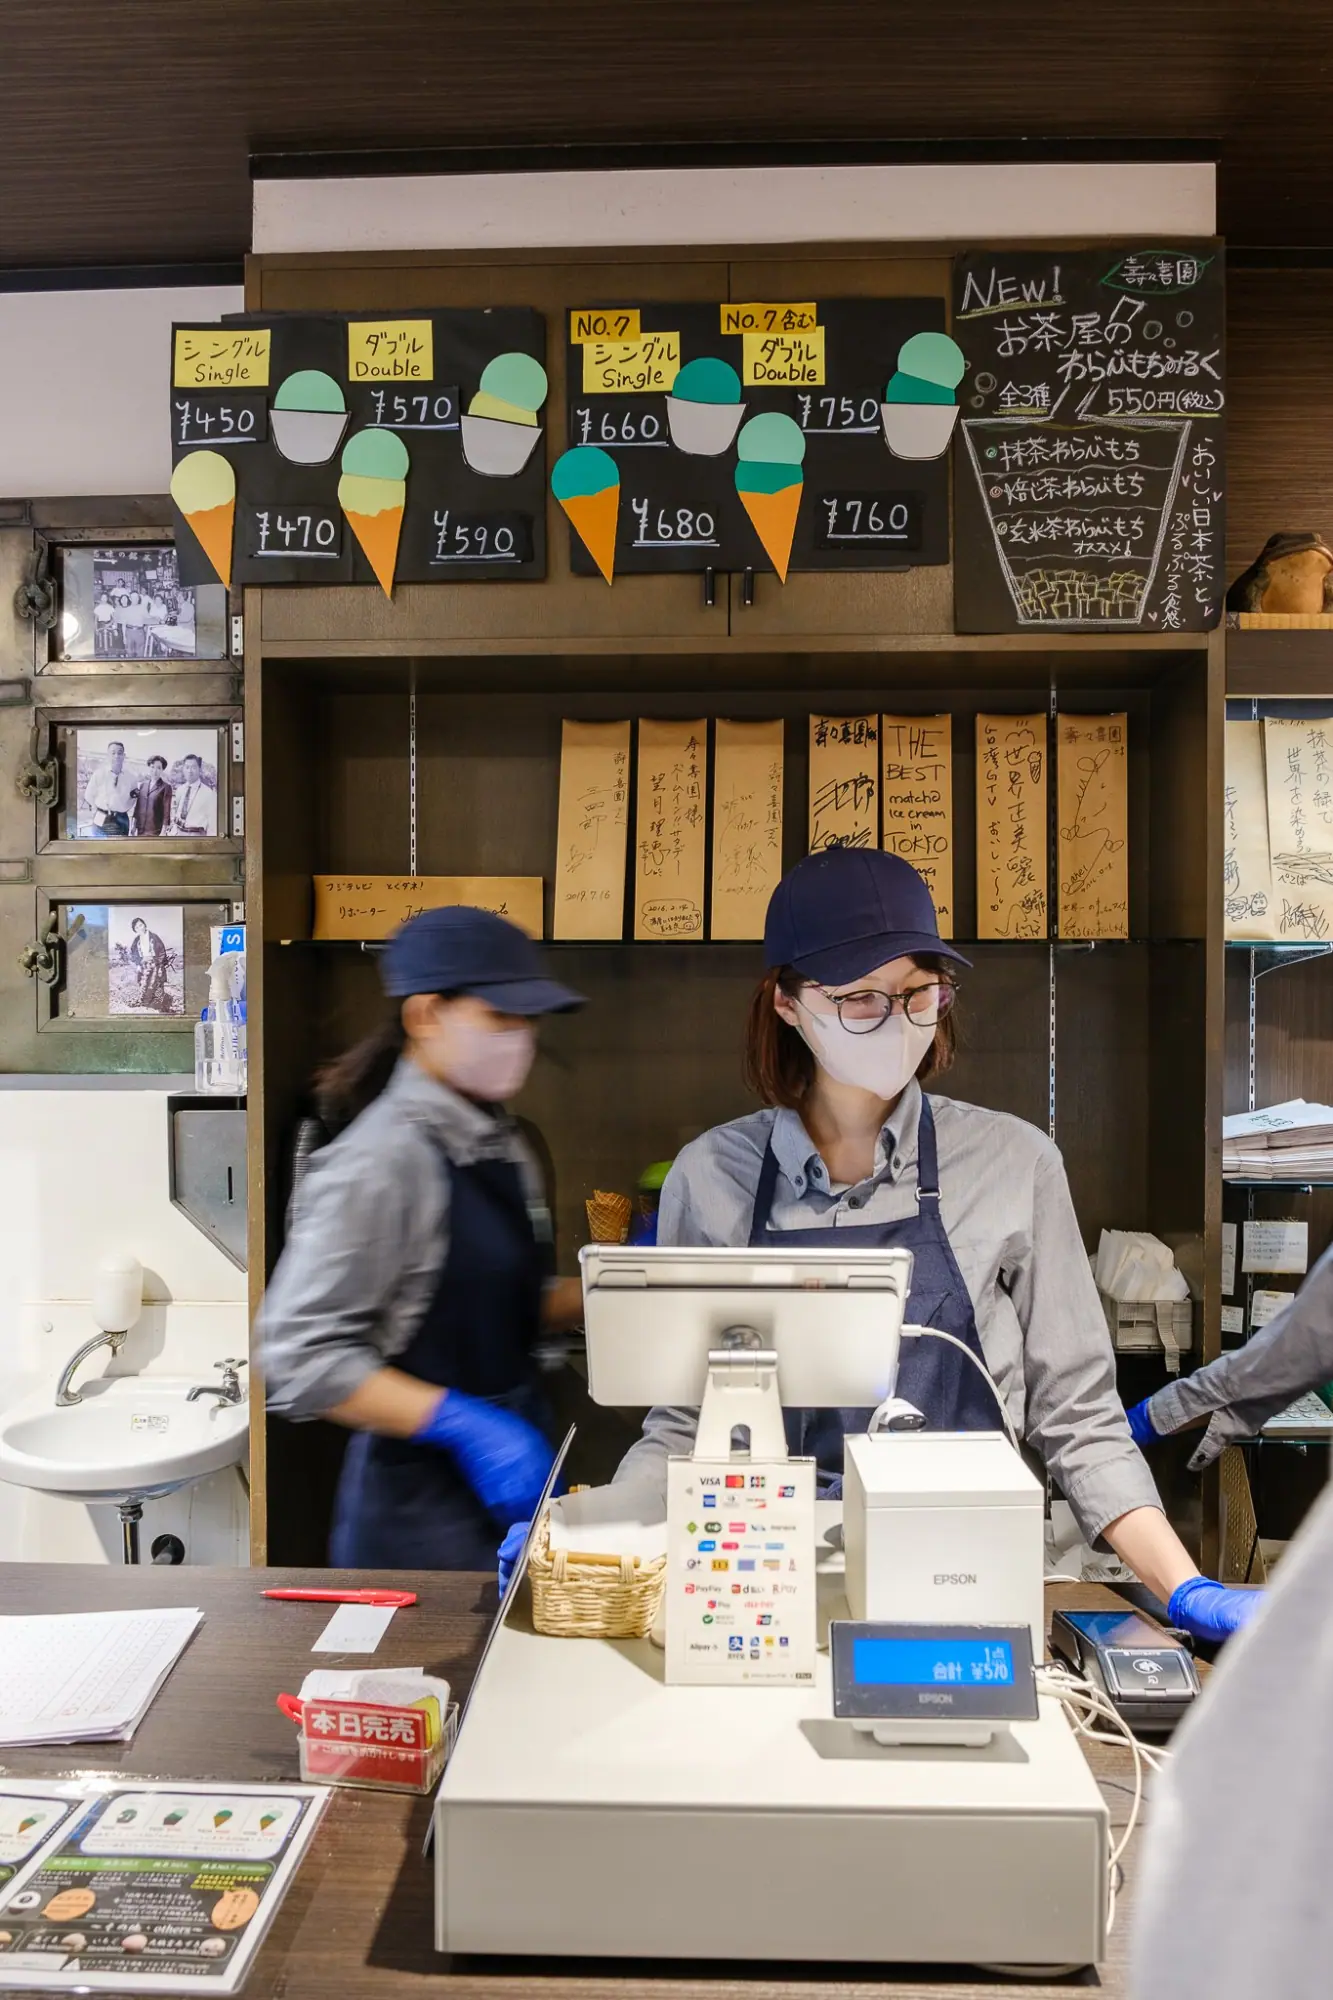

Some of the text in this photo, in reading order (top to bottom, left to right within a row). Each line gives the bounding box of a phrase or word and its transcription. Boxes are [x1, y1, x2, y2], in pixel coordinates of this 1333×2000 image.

[962, 265, 1063, 312] NEW!
[577, 315, 630, 336] NO.7
[994, 313, 1133, 357] お茶屋の
[184, 338, 267, 360] シングル
[366, 332, 424, 356] ダブル
[595, 337, 678, 363] シングル
[760, 338, 818, 363] ダブル
[194, 364, 251, 384] Single
[354, 361, 421, 377] Double
[602, 368, 664, 389] Single
[753, 362, 818, 382] Double
[371, 390, 451, 423] ¥570
[798, 394, 878, 427] ¥750
[175, 401, 254, 440] ¥450
[577, 408, 659, 443] ¥660
[999, 436, 1140, 471] 抹茶わらびもち
[632, 498, 714, 542] ¥680
[824, 499, 908, 533] ¥760
[1188, 437, 1216, 603] おいしい日本茶と
[256, 512, 335, 550] ¥470
[434, 511, 514, 554] ¥590
[1009, 515, 1145, 544] 玄米茶わらびもち
[889, 726, 944, 760] THE
[887, 763, 946, 782] BEST
[889, 789, 941, 804] matcha
[907, 809, 946, 820] cream
[909, 820, 923, 831] in
[883, 831, 949, 855] TOKYO
[933, 1574, 978, 1586] EPSON
[918, 1693, 953, 1705] EPSON
[310, 1710, 416, 1745] 本日完売
